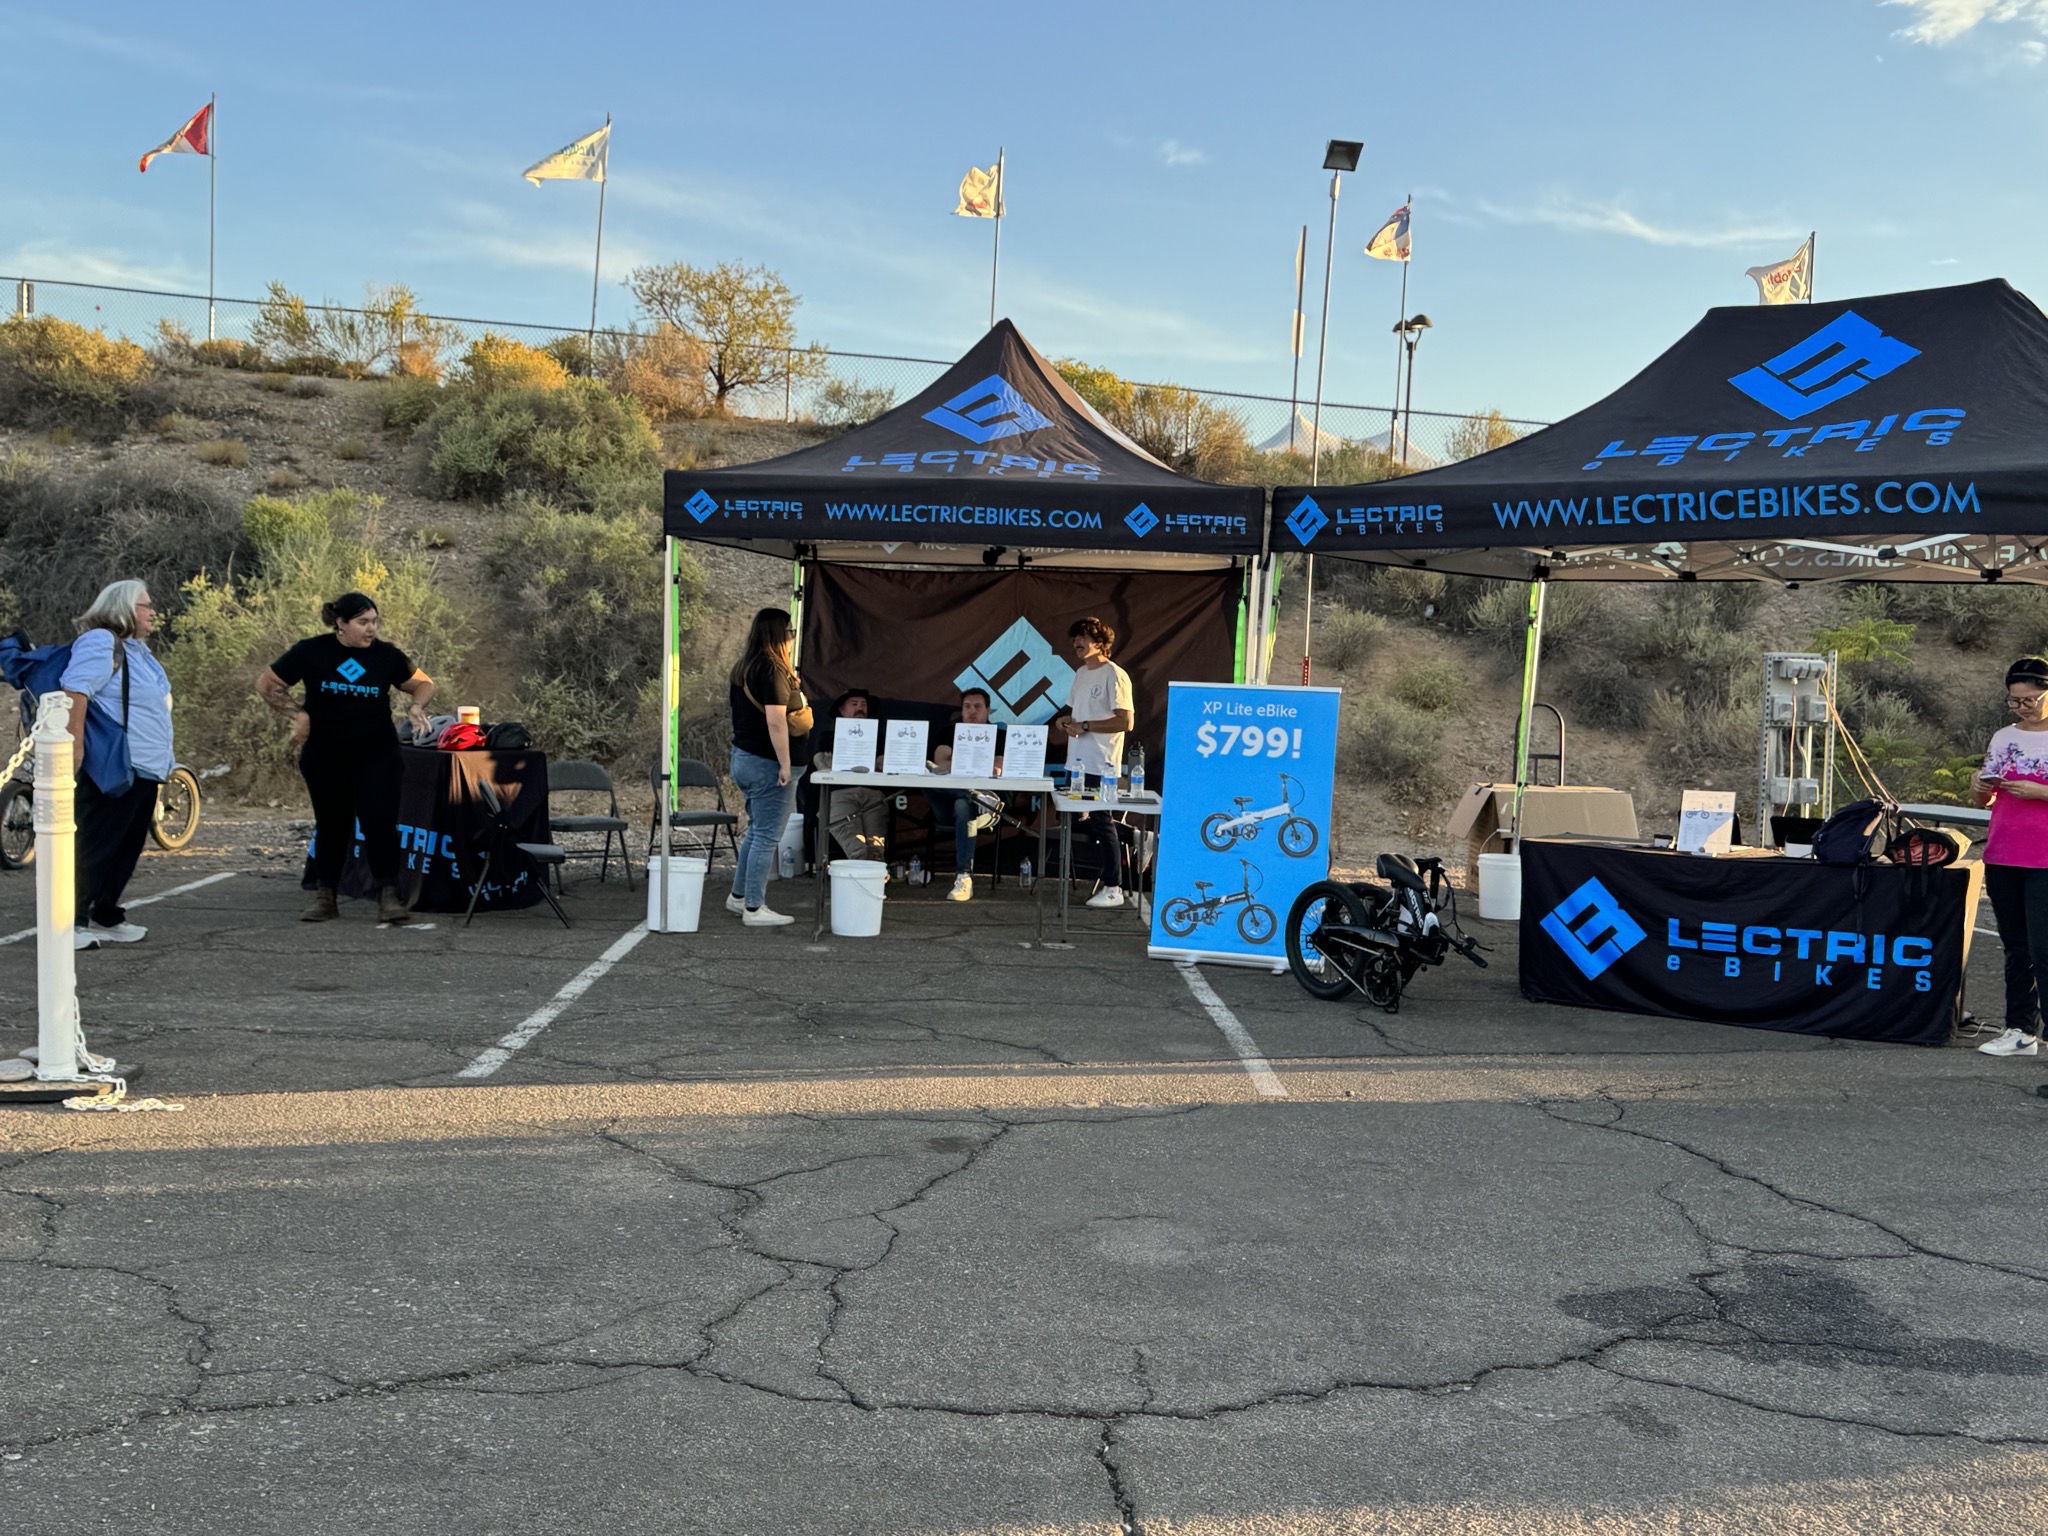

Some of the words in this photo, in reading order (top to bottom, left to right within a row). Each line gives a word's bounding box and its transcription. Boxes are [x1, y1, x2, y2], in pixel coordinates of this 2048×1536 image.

[1595, 408, 1967, 460] LECTRIC
[846, 450, 1100, 476] LECTRIC
[724, 499, 803, 513] LECTRIC
[825, 503, 1102, 530] WWW.LECTRICEBIKES.COM
[1337, 504, 1443, 523] LECTRIC
[1492, 480, 1981, 528] WWW.LECTRICEBIKES.COM
[1165, 513, 1247, 527] LECTRIC
[1202, 701, 1223, 715] XP
[1226, 702, 1253, 716] Lite
[1256, 704, 1298, 718] eBike
[1196, 720, 1302, 759] $799!
[1667, 917, 1933, 967] LECTRIC
